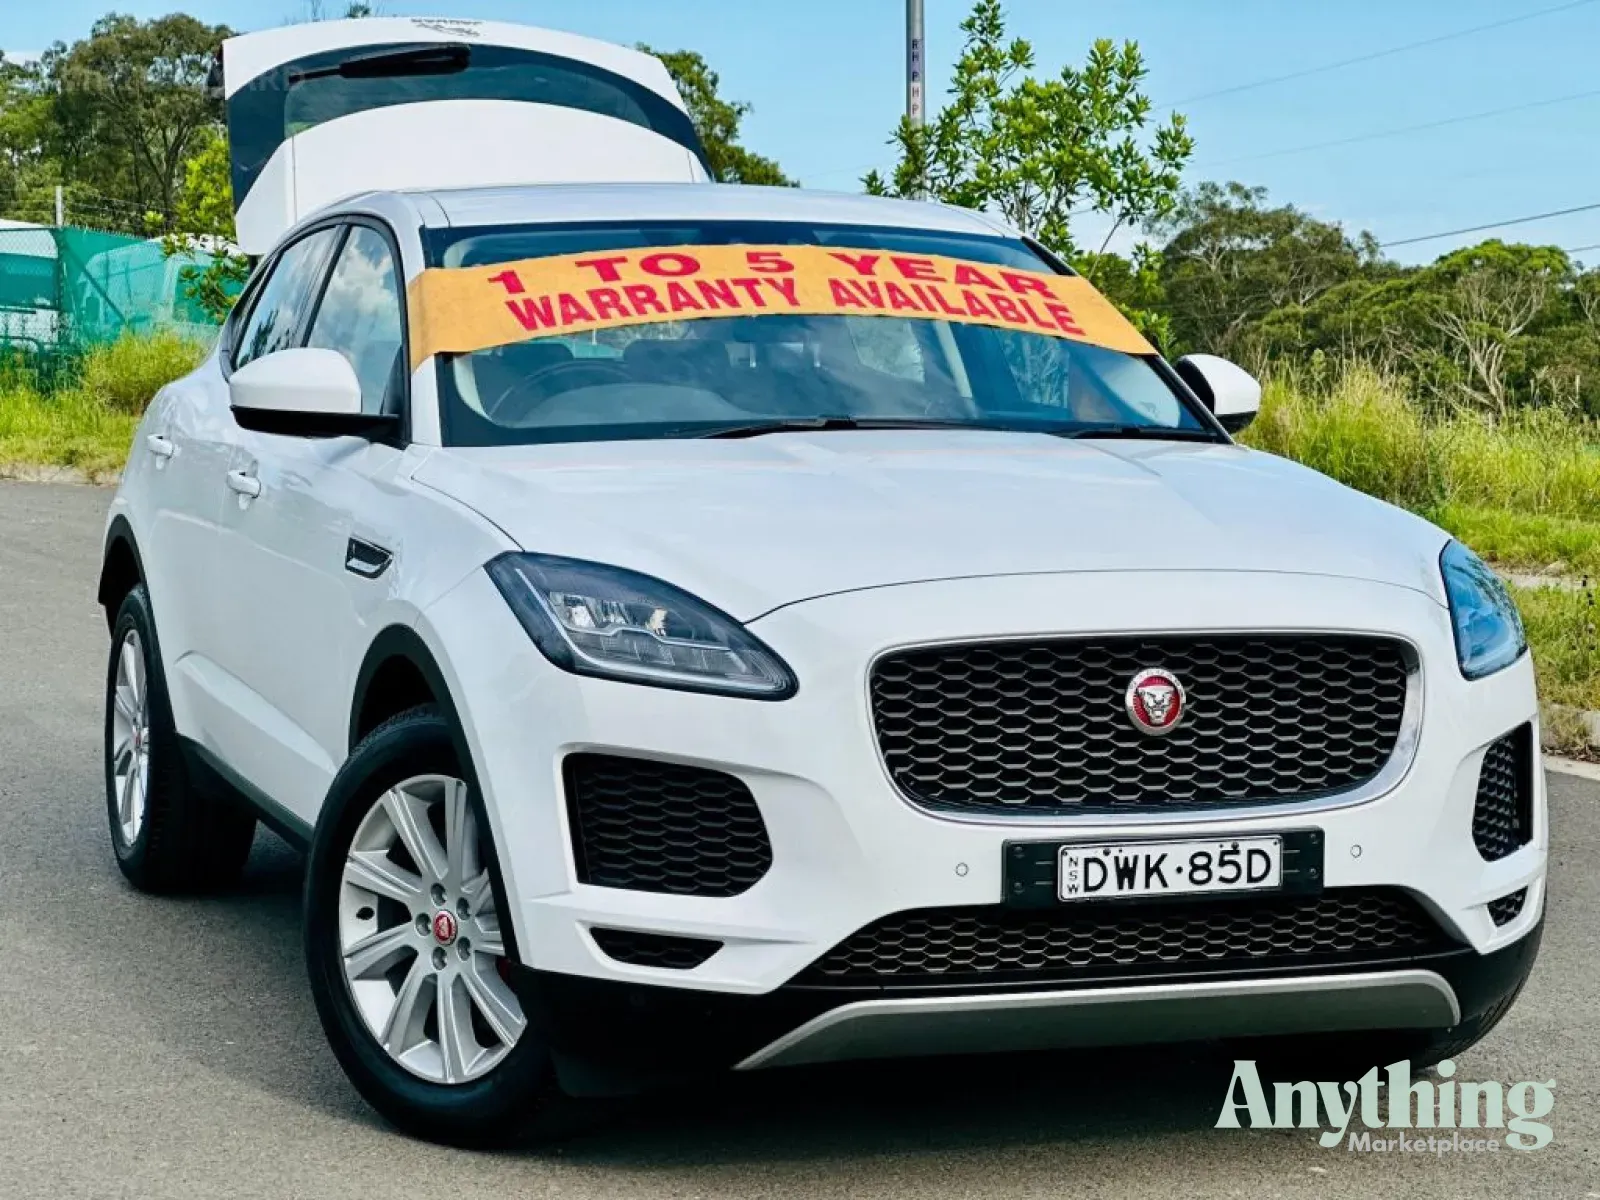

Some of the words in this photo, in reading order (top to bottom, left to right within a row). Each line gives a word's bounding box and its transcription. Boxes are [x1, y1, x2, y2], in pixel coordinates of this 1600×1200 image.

[487, 269, 526, 295] 1
[575, 252, 701, 283] TO
[746, 251, 795, 273] 5
[828, 252, 1061, 299] YEAR
[505, 278, 800, 332] WARRANTY
[828, 277, 1087, 336] AVAILABLE
[1067, 856, 1081, 895] NSW
